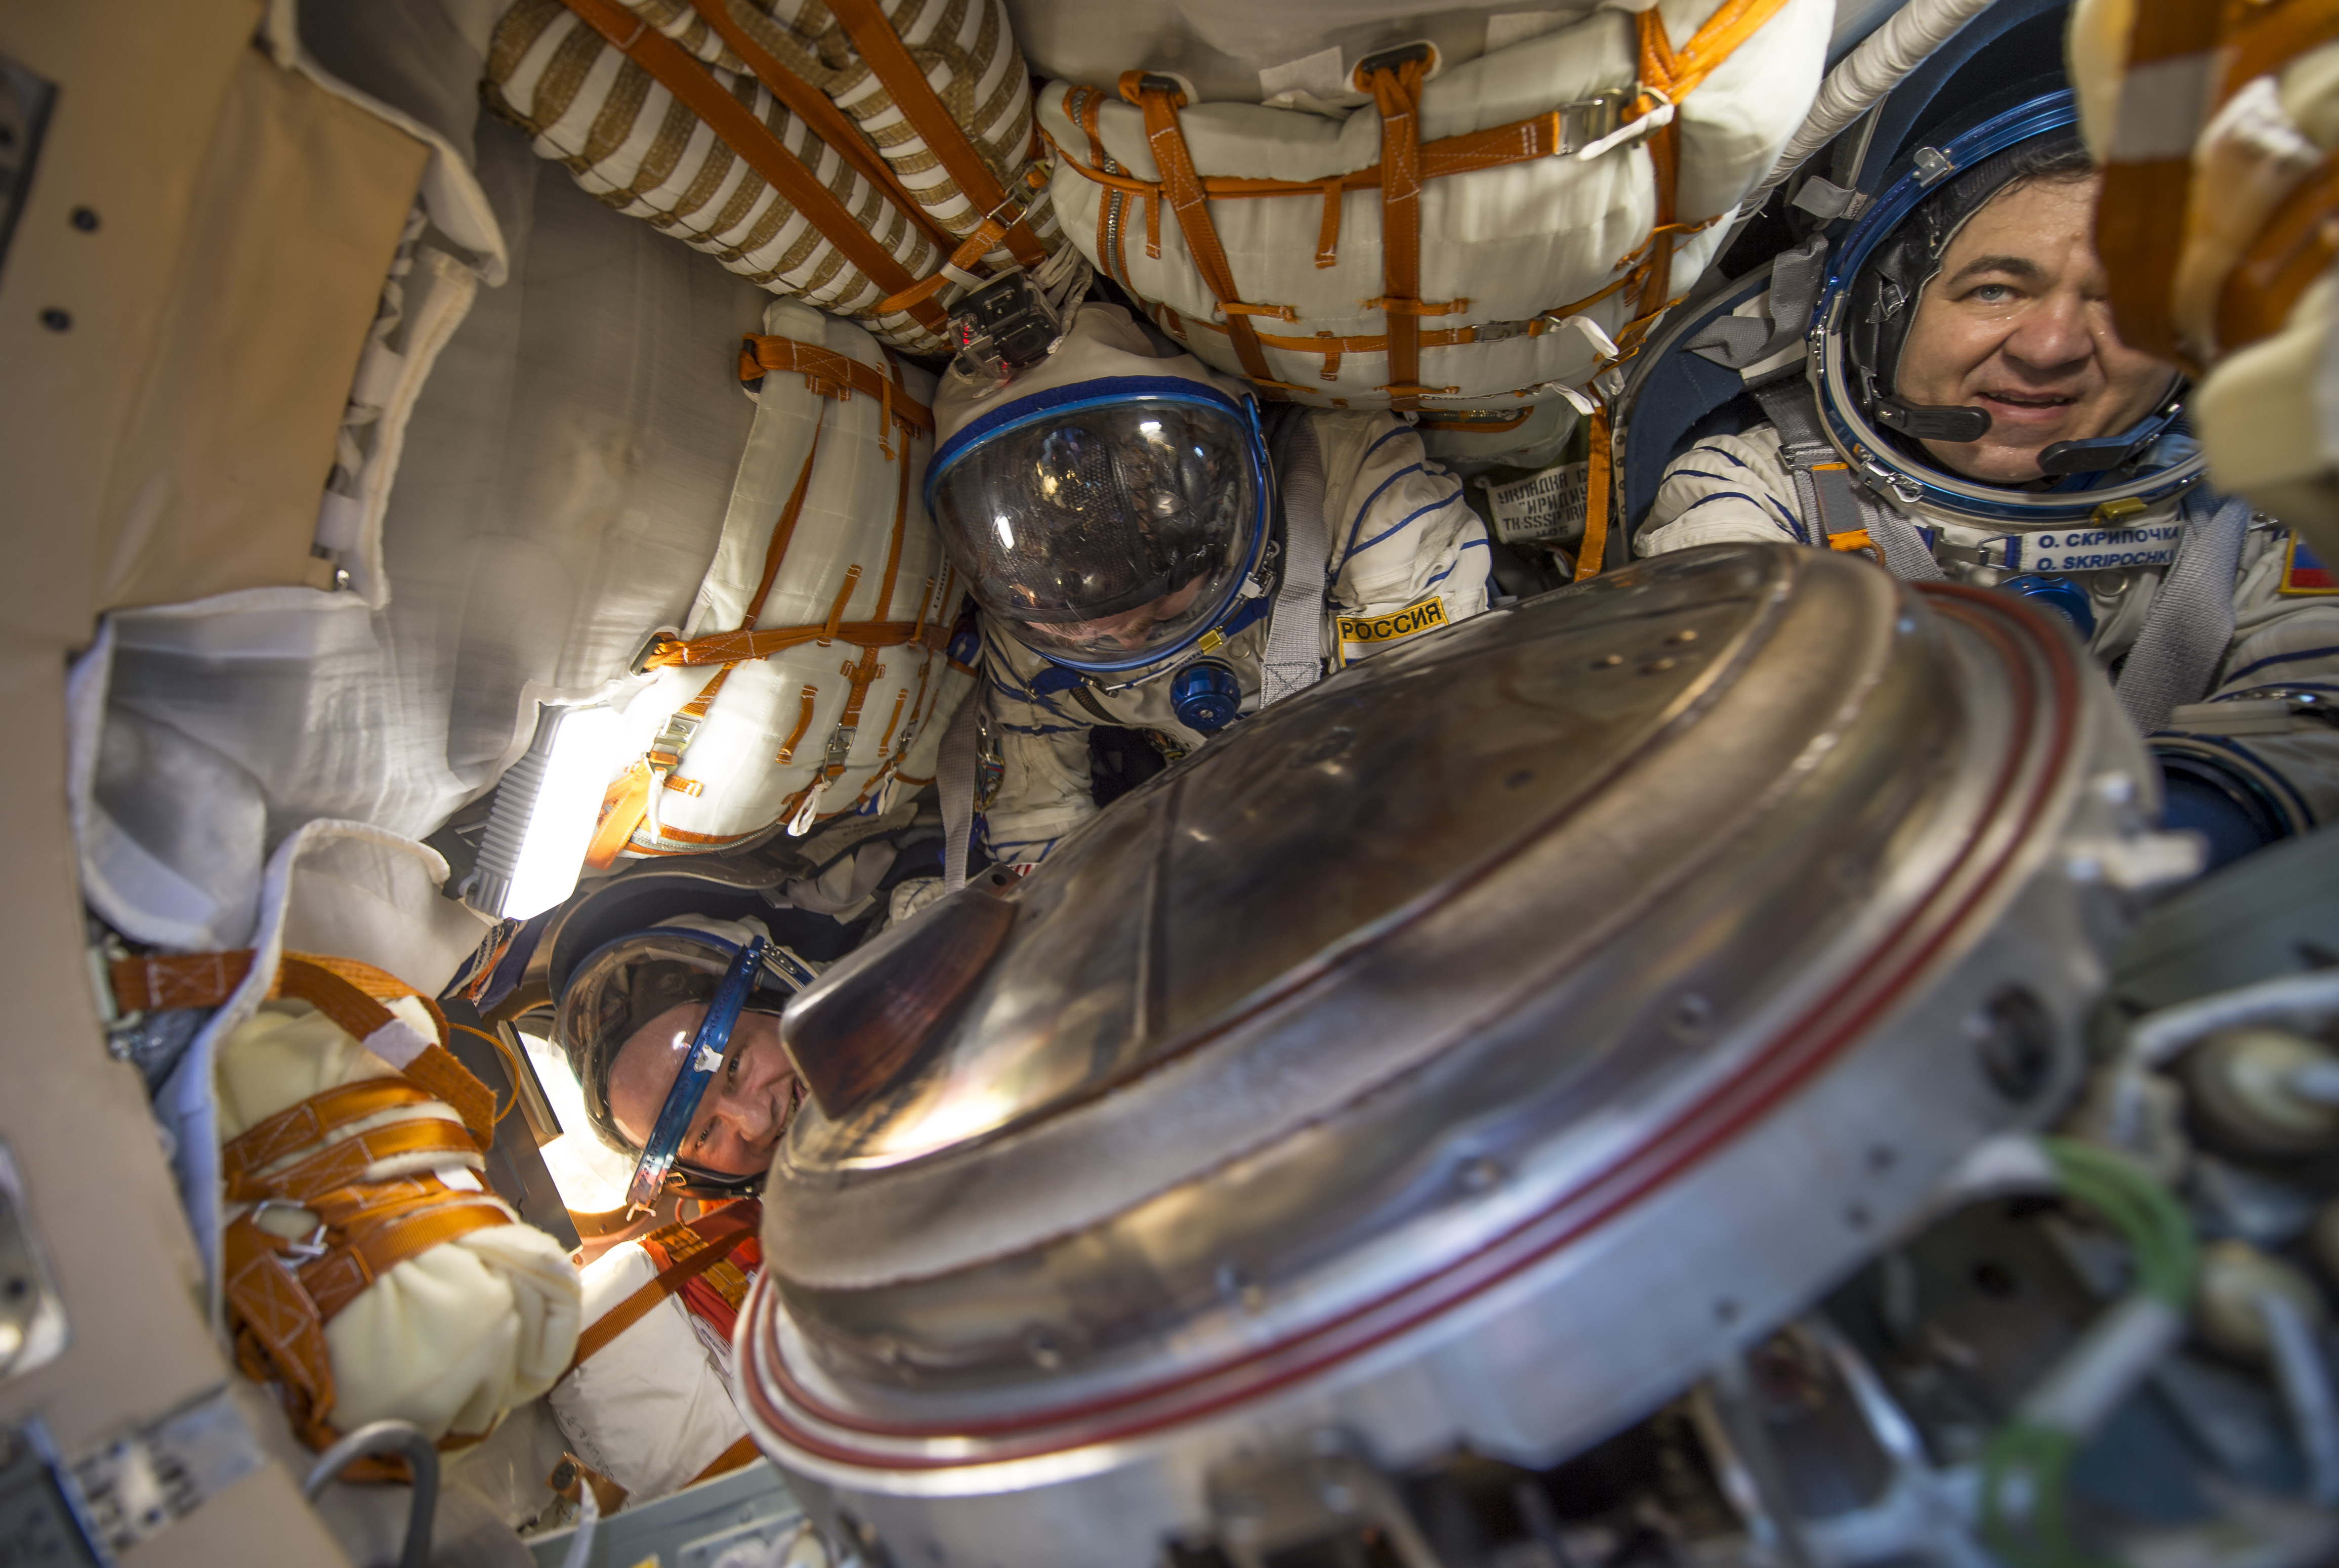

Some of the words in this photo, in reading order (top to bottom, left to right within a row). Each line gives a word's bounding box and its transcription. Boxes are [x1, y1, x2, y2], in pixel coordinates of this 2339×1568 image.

[1498, 472, 1568, 504] УКЛАДКА
[2038, 534, 2060, 548] О.
[2037, 558, 2056, 571] O.
[1341, 603, 1441, 640] РОССИЯ
